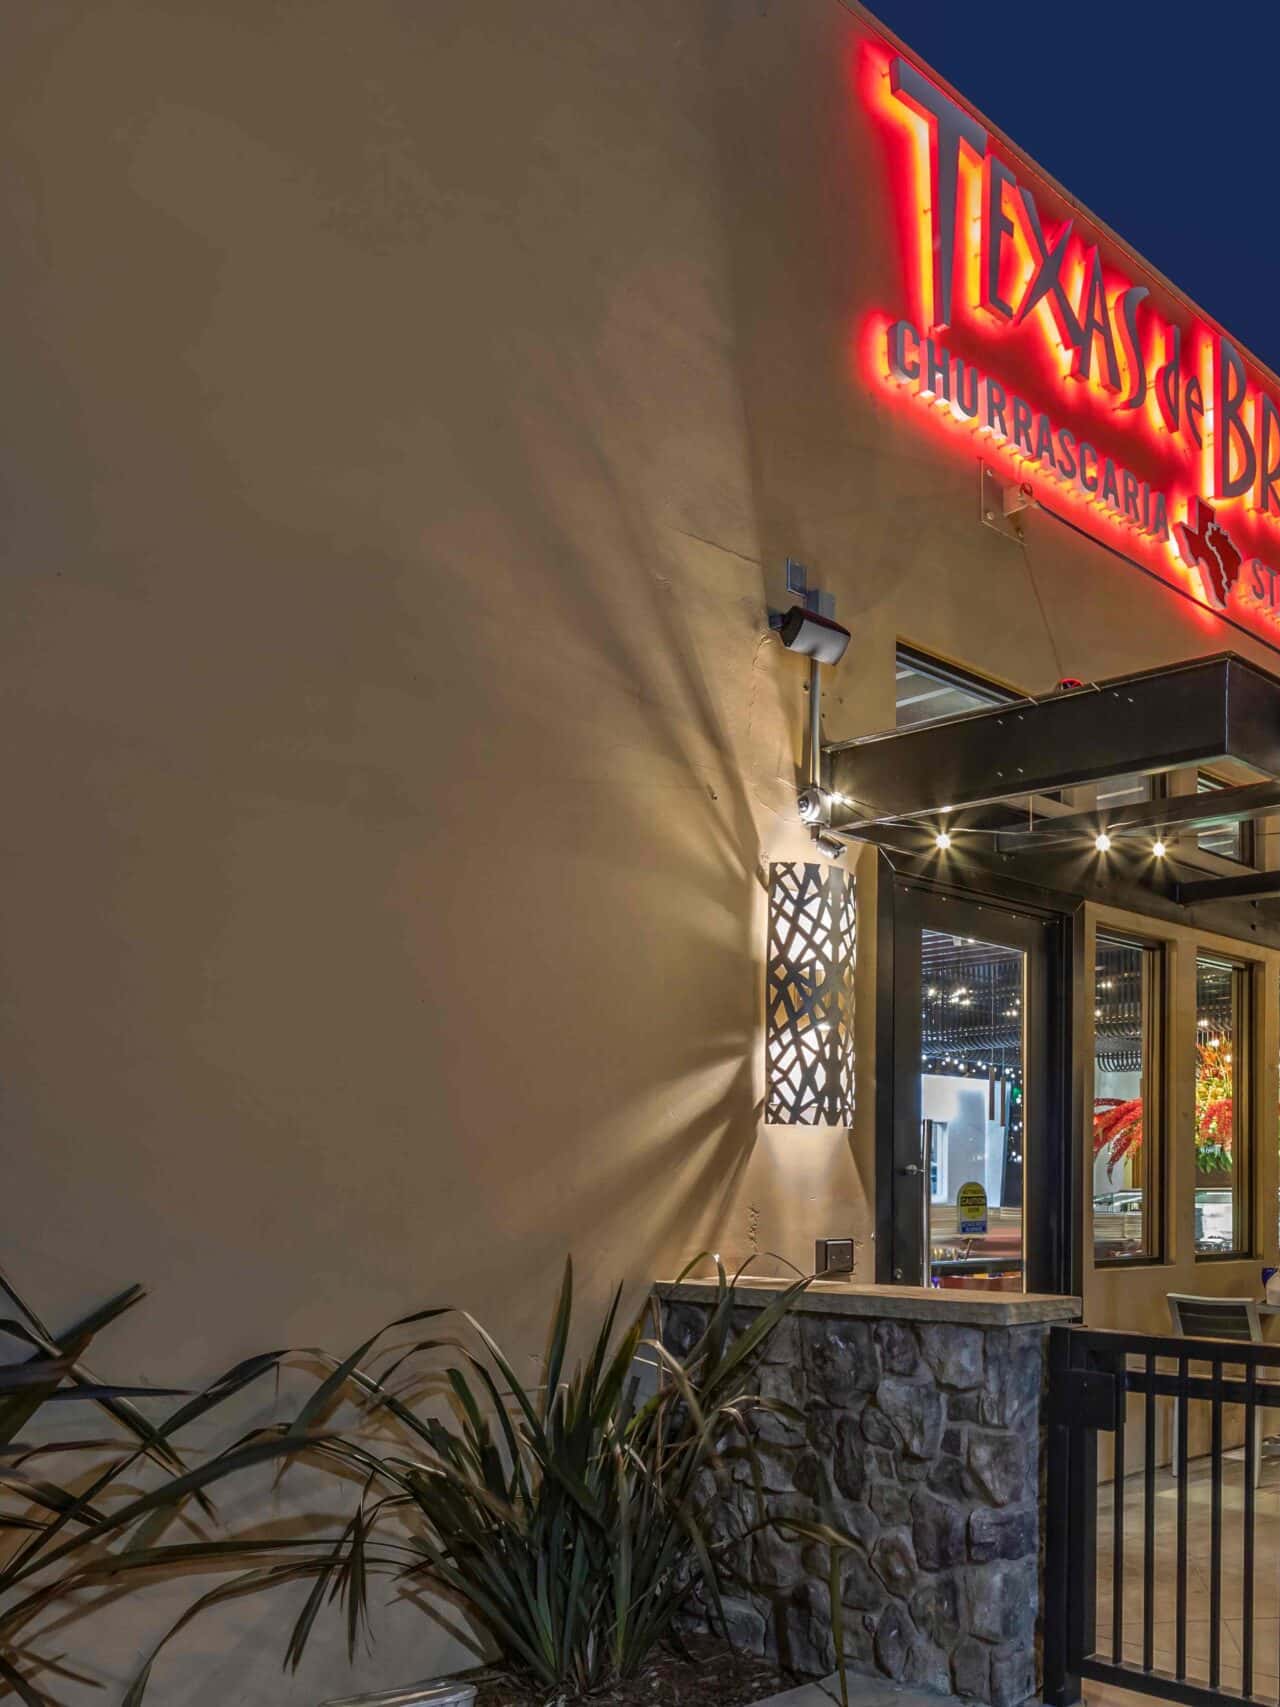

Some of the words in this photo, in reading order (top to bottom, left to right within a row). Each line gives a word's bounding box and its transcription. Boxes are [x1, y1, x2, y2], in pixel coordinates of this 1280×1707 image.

[891, 56, 1149, 409] TEXAS
[1157, 324, 1204, 451] de
[887, 320, 1170, 543] CHURRASCARIA
